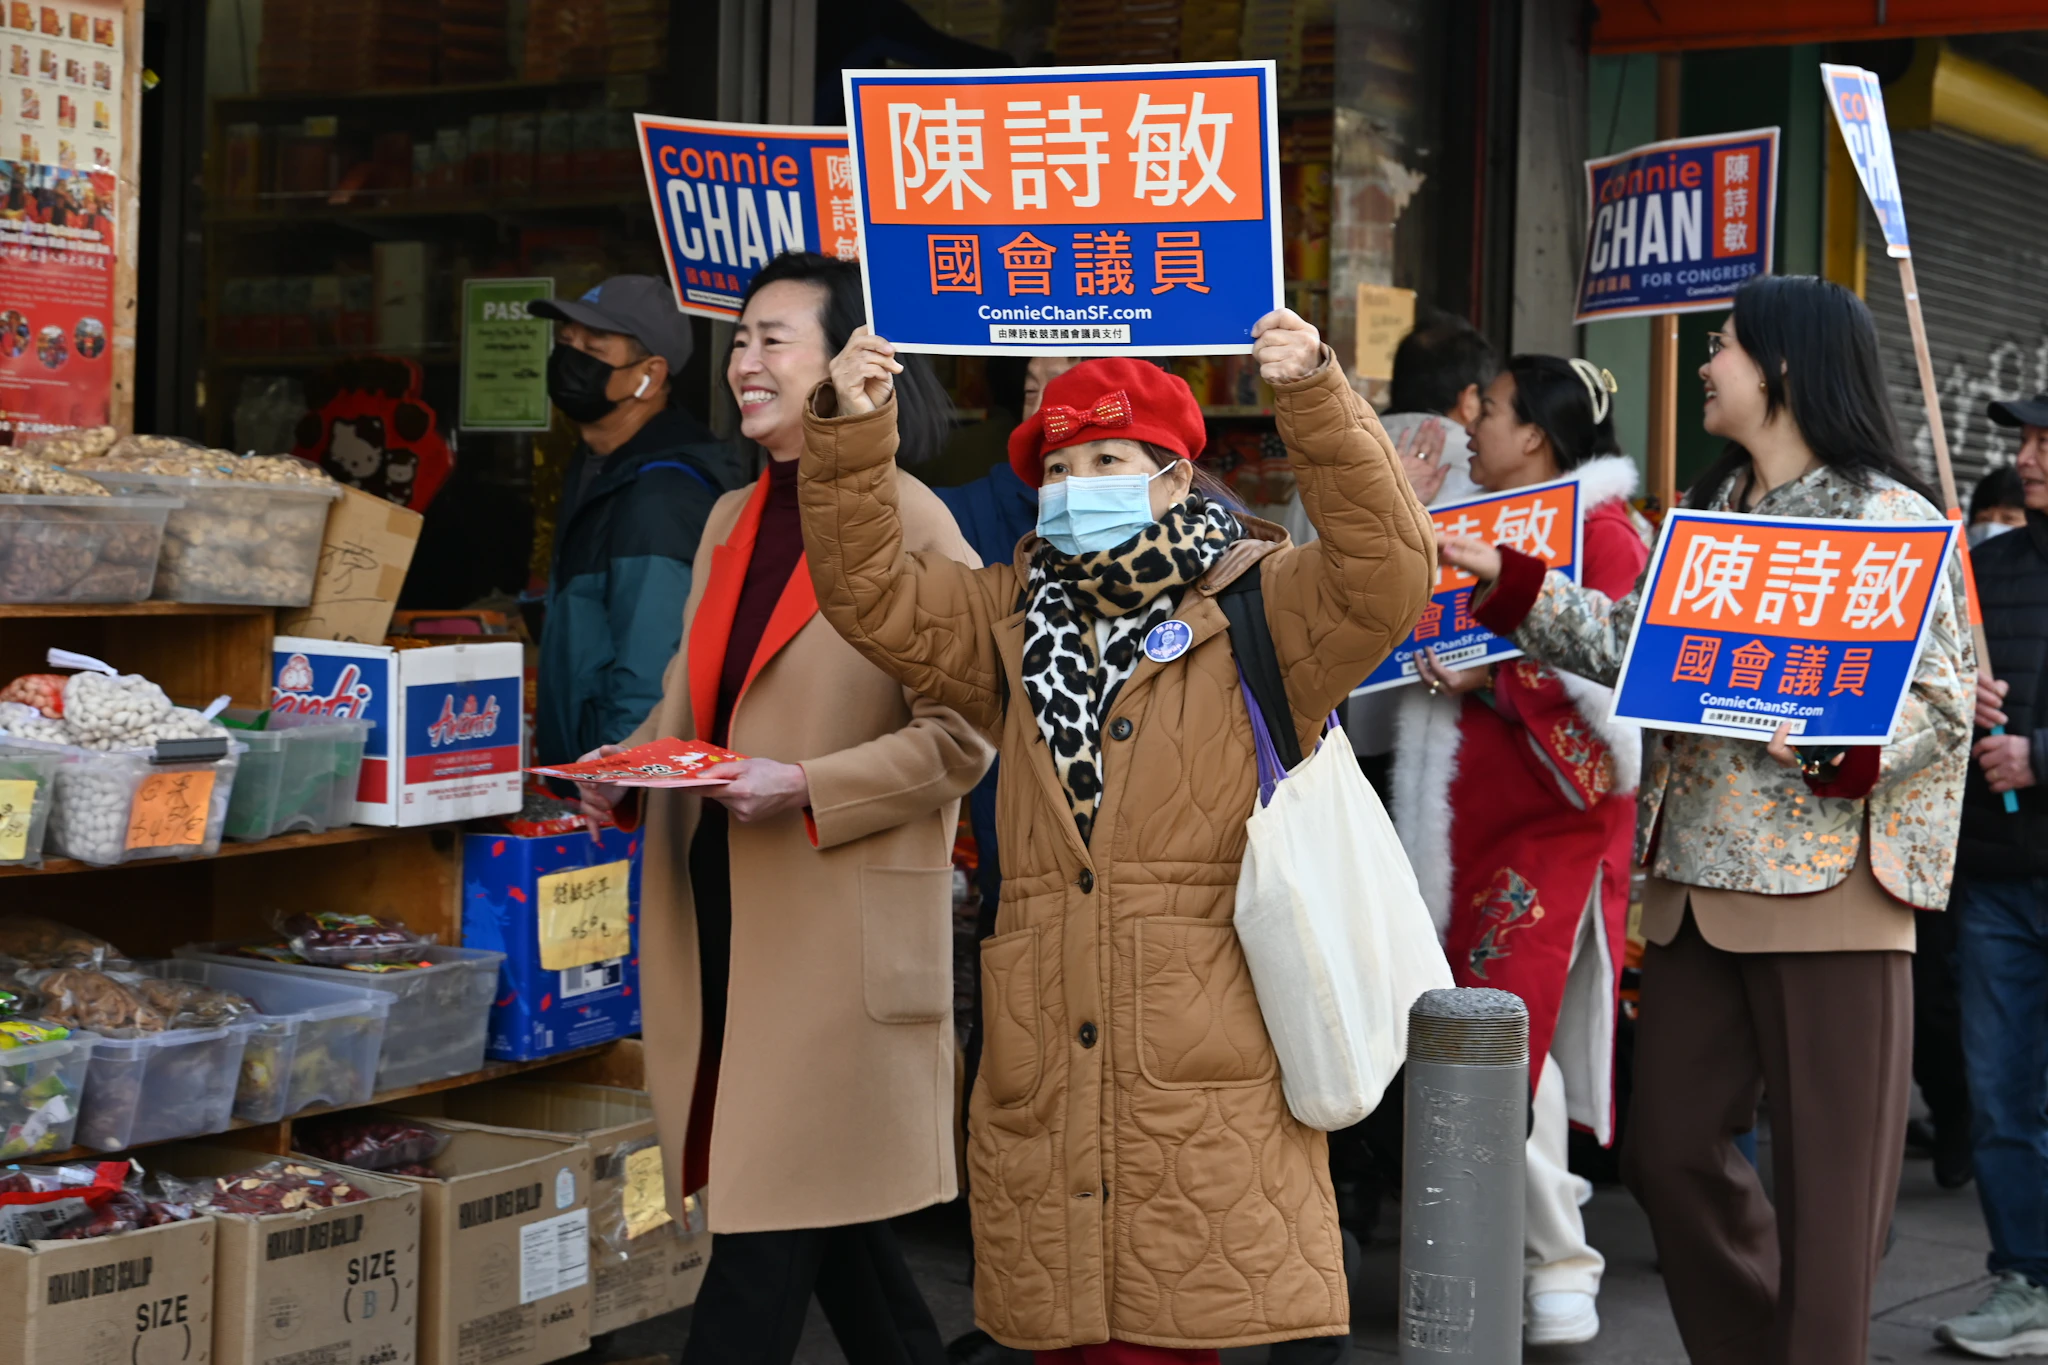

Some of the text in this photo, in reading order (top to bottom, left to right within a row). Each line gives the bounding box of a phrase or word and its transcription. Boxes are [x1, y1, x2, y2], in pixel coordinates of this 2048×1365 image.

[659, 142, 799, 187] connie
[888, 91, 1237, 211] 陳詩敏
[1600, 153, 1703, 203] connie
[1723, 154, 1749, 252] 陳詩敏
[666, 178, 806, 270] CHAN
[1590, 189, 1703, 274] CHAN
[927, 230, 1211, 297] 國會議員
[1641, 262, 1757, 288] FOR CONGRESS
[978, 305, 1152, 320] ConnieChanSF.com
[998, 328, 1123, 340] 由陳詩敏競選國會議員支付
[1669, 534, 1923, 630] 陳詩敏
[1671, 634, 1873, 697] 國會議員
[1699, 692, 1824, 717] ConnieChanSF.com
[347, 1250, 396, 1285] SIZE
[136, 1294, 188, 1332] SIZE
